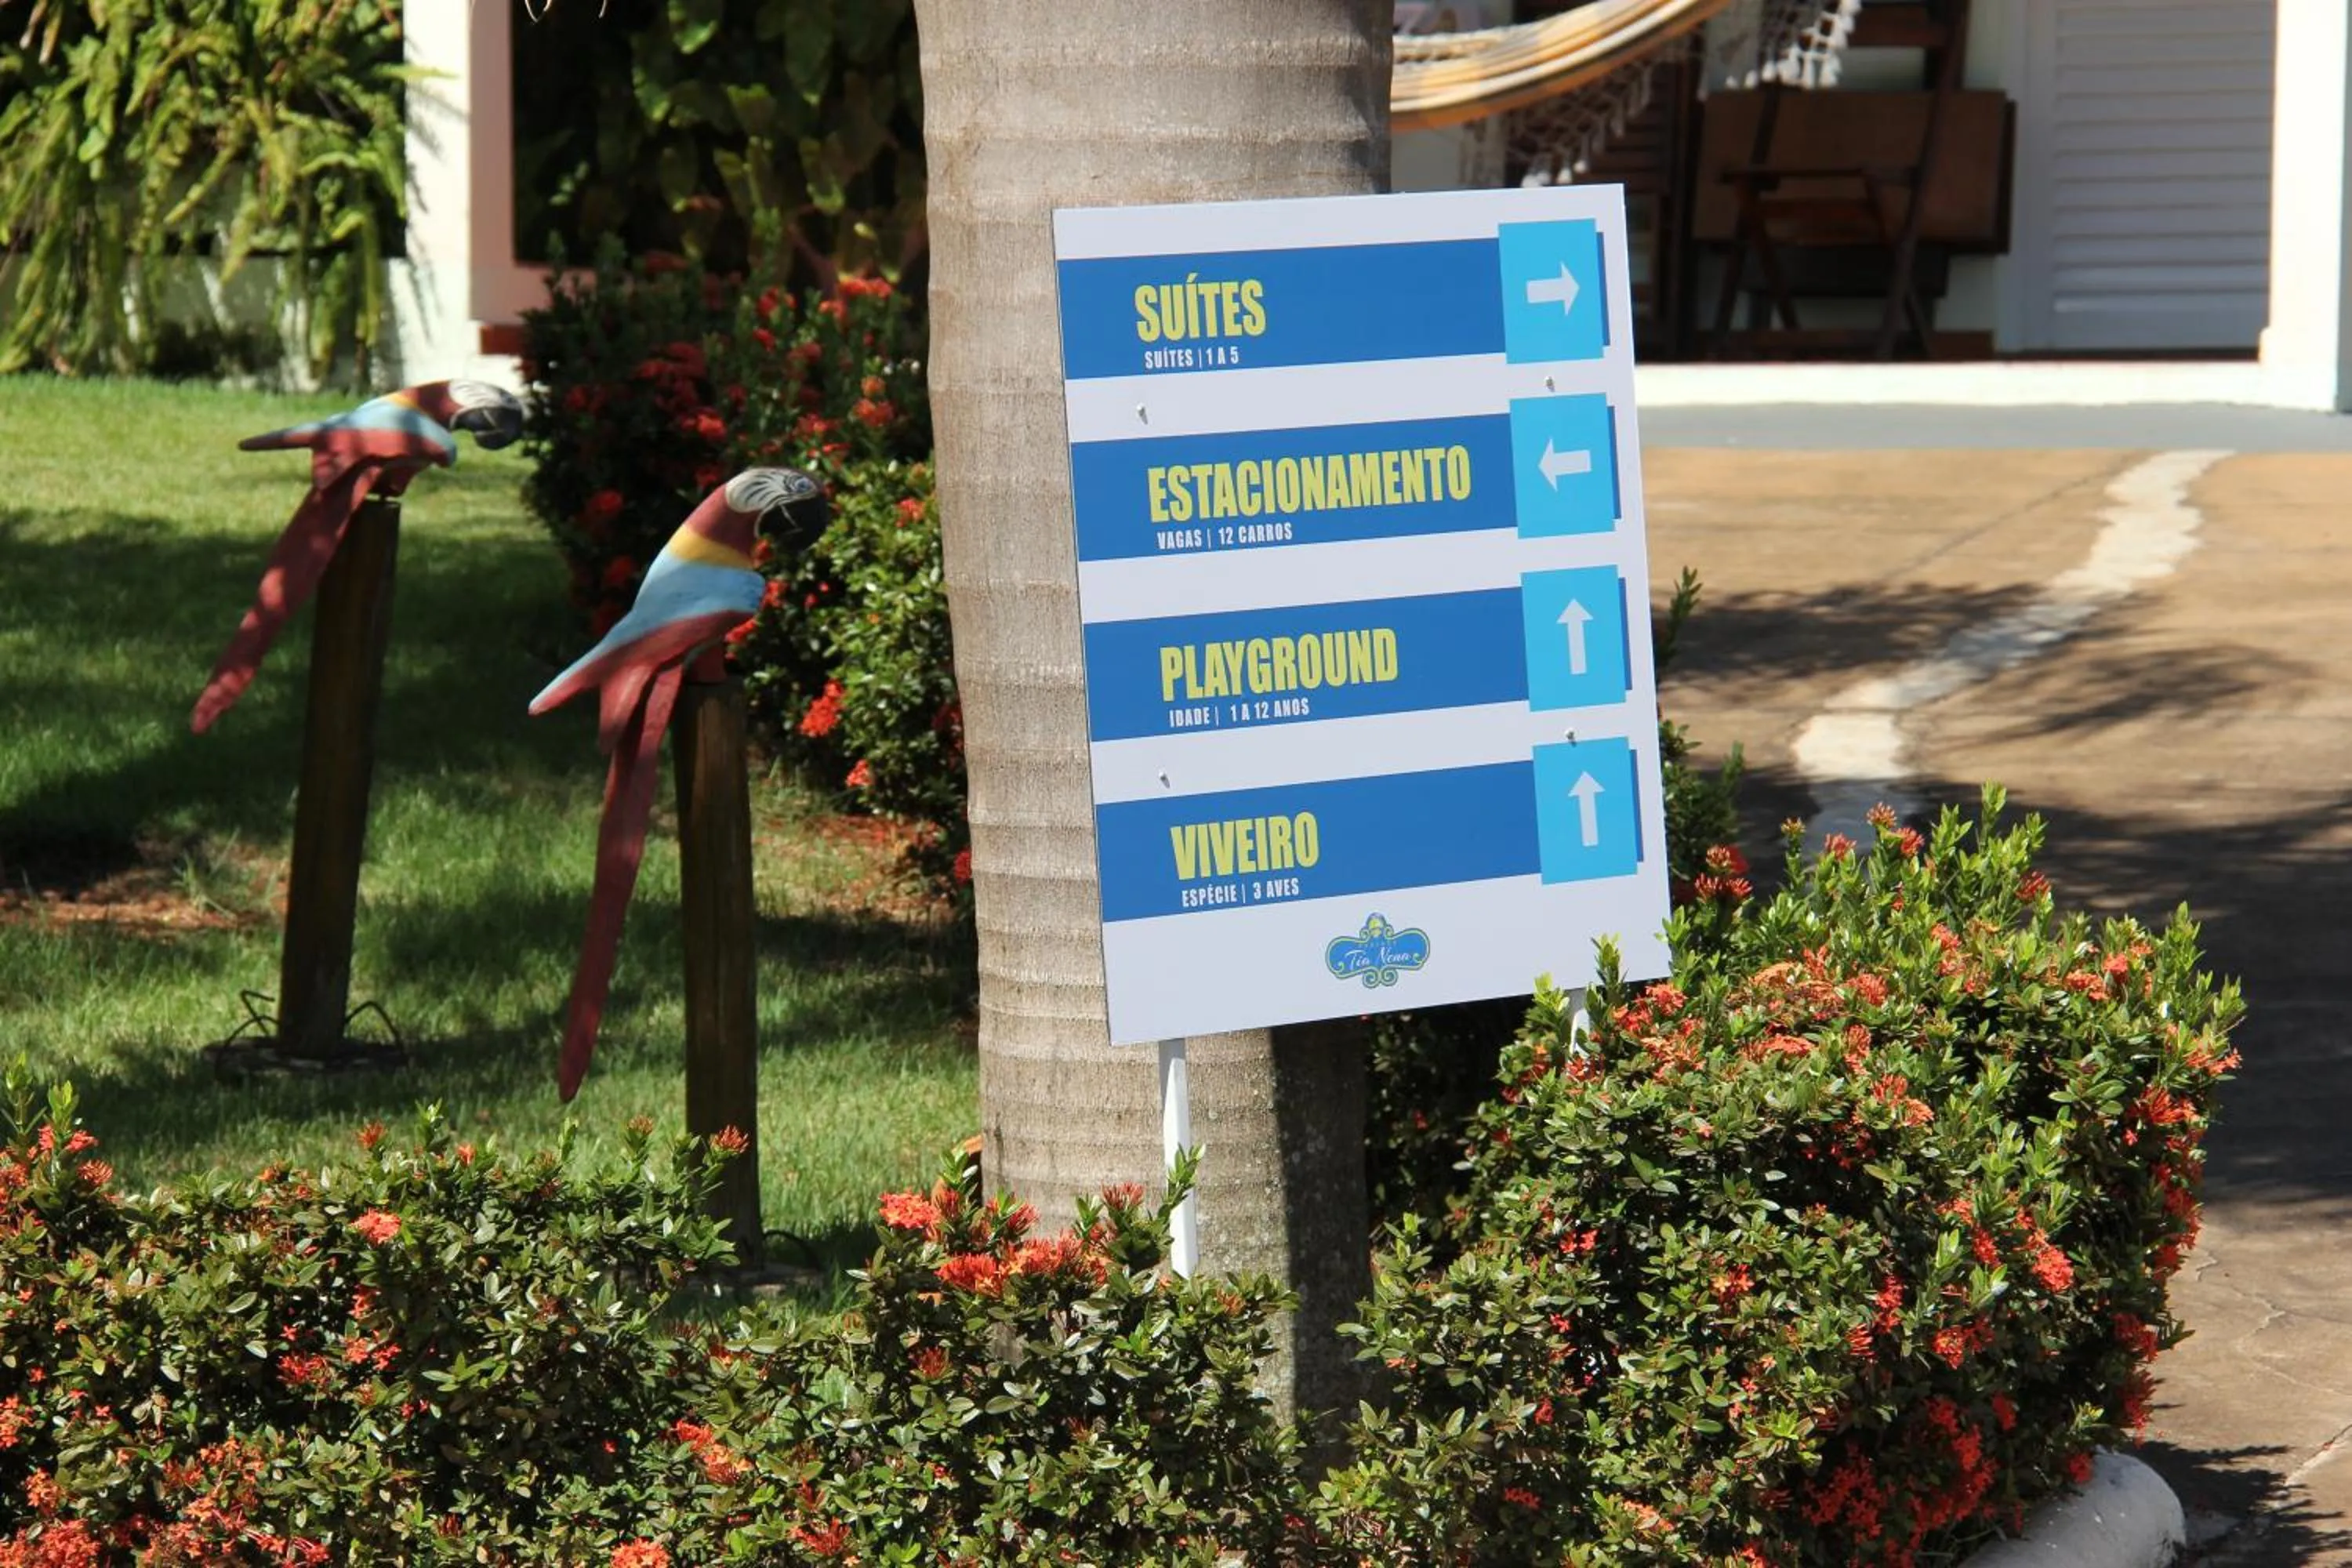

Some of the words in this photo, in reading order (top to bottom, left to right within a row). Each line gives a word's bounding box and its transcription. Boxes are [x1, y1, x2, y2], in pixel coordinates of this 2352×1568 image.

[1134, 273, 1266, 342] SUÍTES
[1145, 347, 1193, 368] SUÍTES
[1206, 347, 1213, 365] 1
[1218, 347, 1226, 365] A
[1230, 346, 1240, 364] 5
[1147, 445, 1471, 523] ESTACIONAMENTO
[1157, 529, 1203, 550] VAGAS
[1218, 527, 1234, 544] 12
[1238, 521, 1293, 543] CARROS
[1160, 628, 1398, 702] PLAYGROUND
[1169, 707, 1210, 728] IDADE
[1231, 705, 1237, 722] 1
[1241, 704, 1250, 720] A
[1255, 702, 1269, 719] 12
[1274, 697, 1310, 717] ANOS
[1171, 812, 1319, 880] VIVEIRO
[1181, 884, 1238, 907] ESPÉCIE
[1254, 882, 1262, 899] 3
[1266, 877, 1300, 898] AVES
